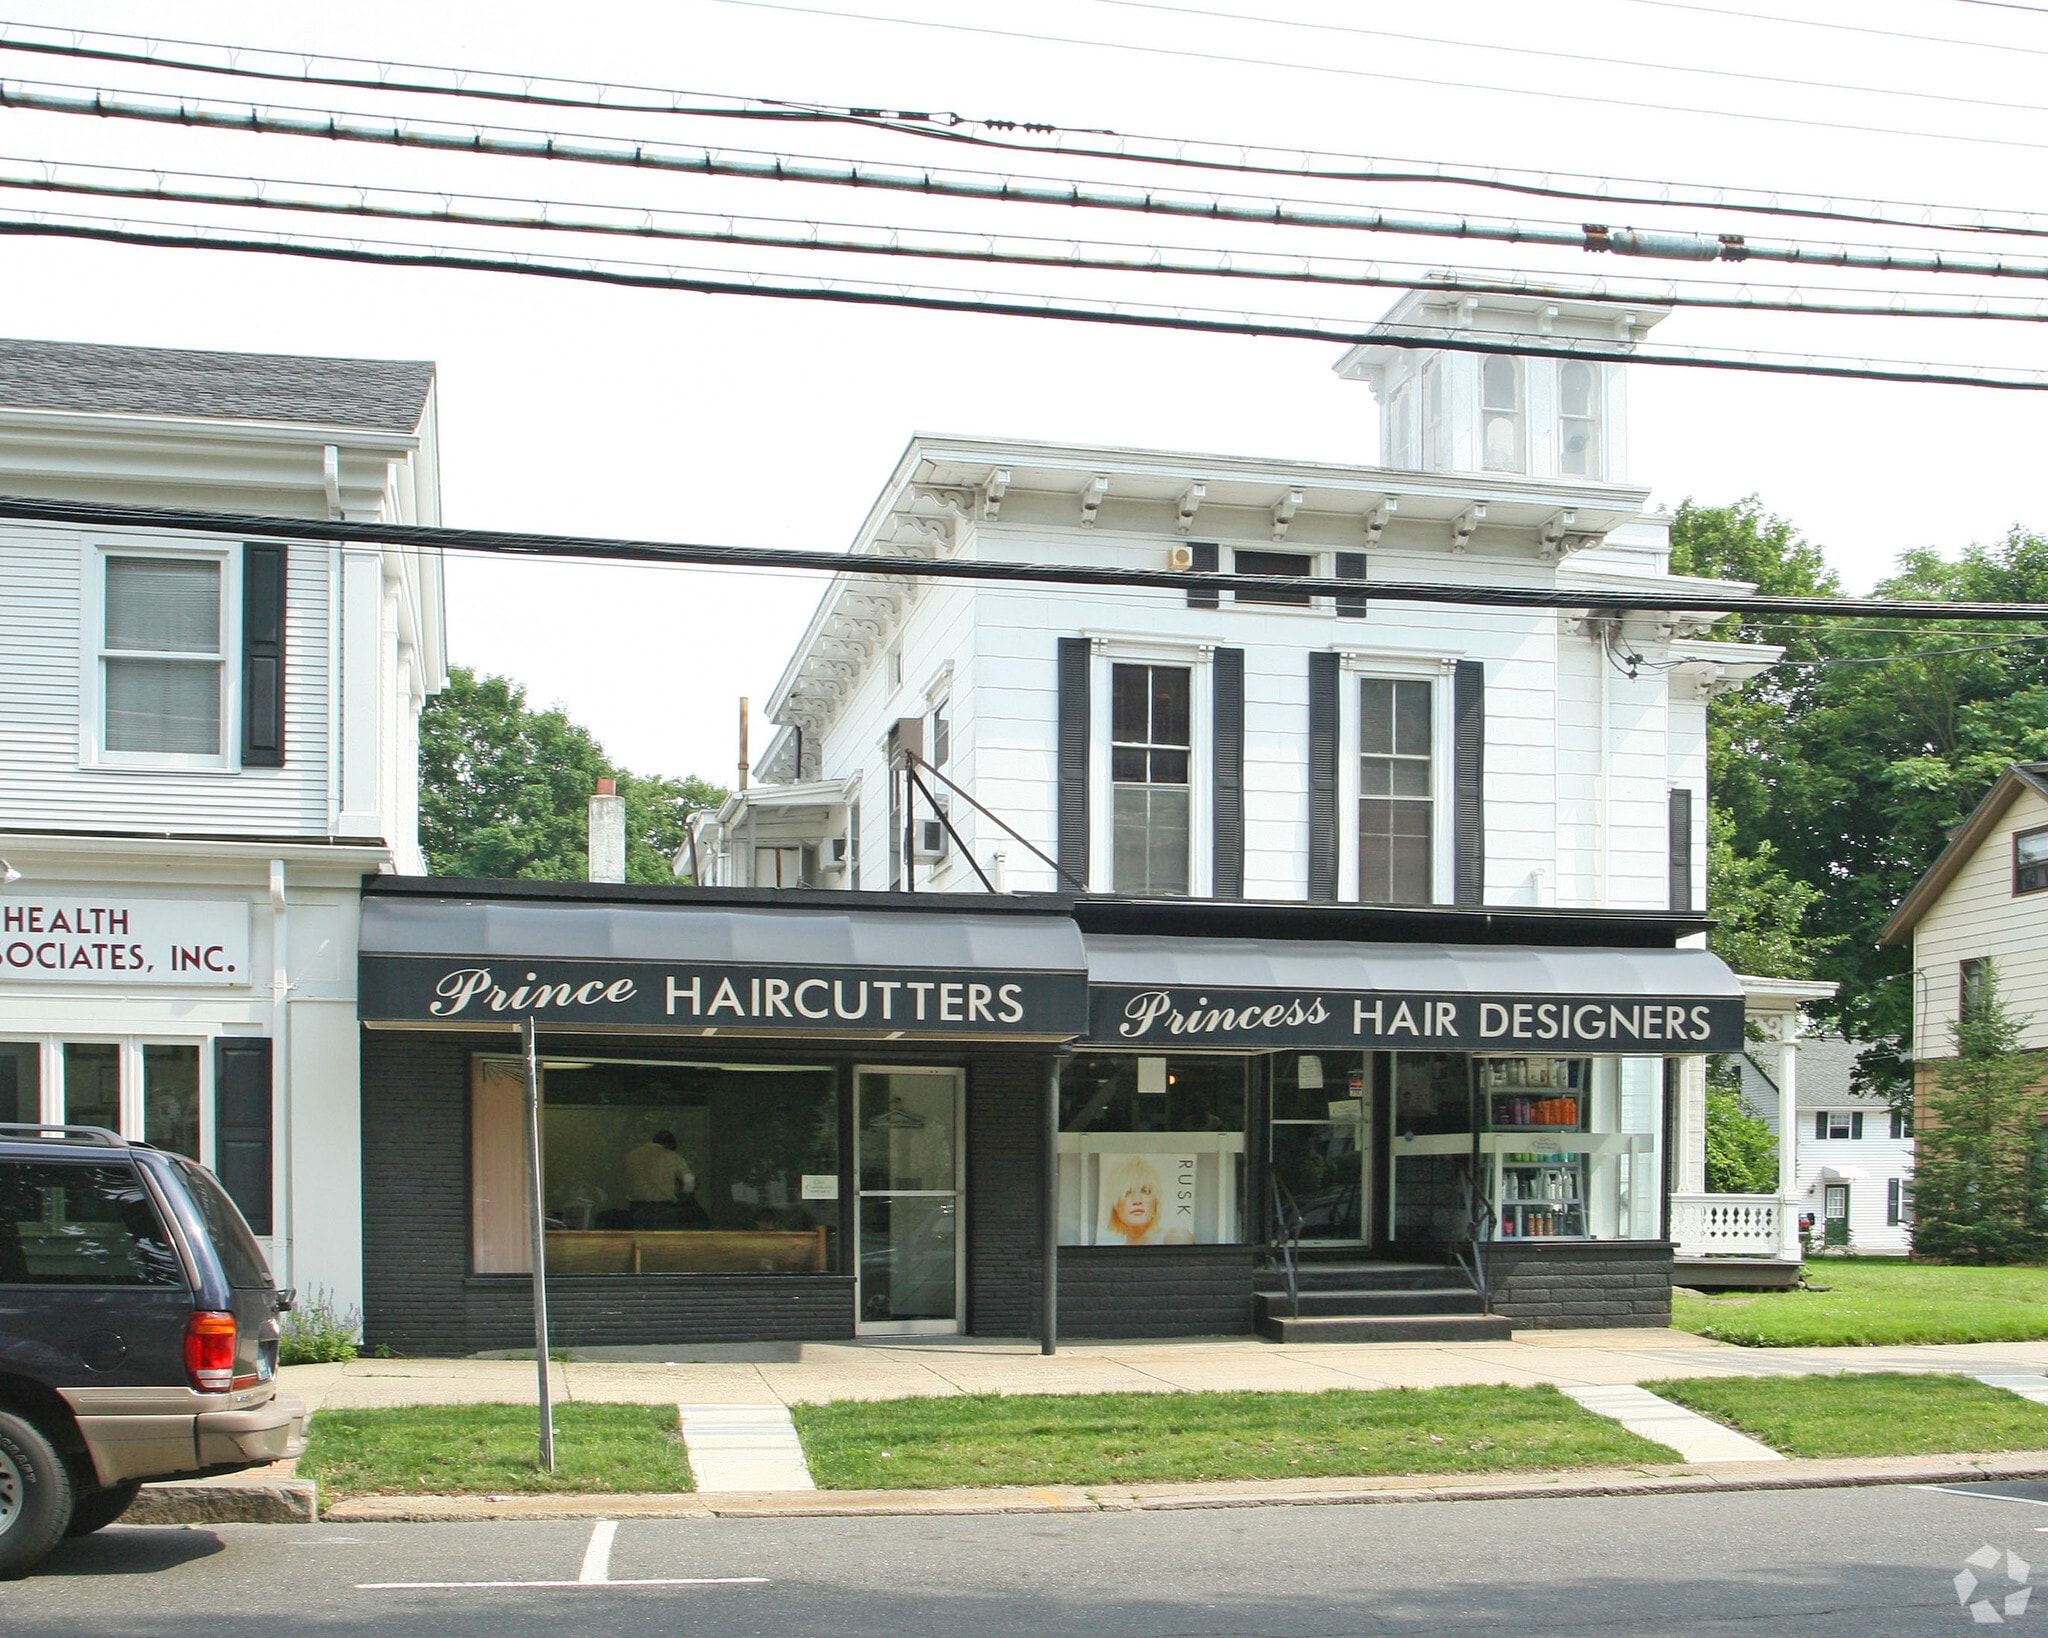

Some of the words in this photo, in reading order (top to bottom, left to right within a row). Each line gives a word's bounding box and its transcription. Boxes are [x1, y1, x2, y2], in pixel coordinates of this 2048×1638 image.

[4, 906, 129, 935] HEALTH
[0, 941, 156, 973] OCIATES,
[171, 945, 236, 973] INC.
[429, 967, 638, 1017] Prince
[665, 976, 1024, 1023] HAIRCUTTERS
[1119, 990, 1331, 1038] Princess
[1353, 999, 1459, 1038] HAIR
[1479, 1002, 1712, 1041] DESIGNERS
[1176, 1159, 1194, 1216] RUSK
